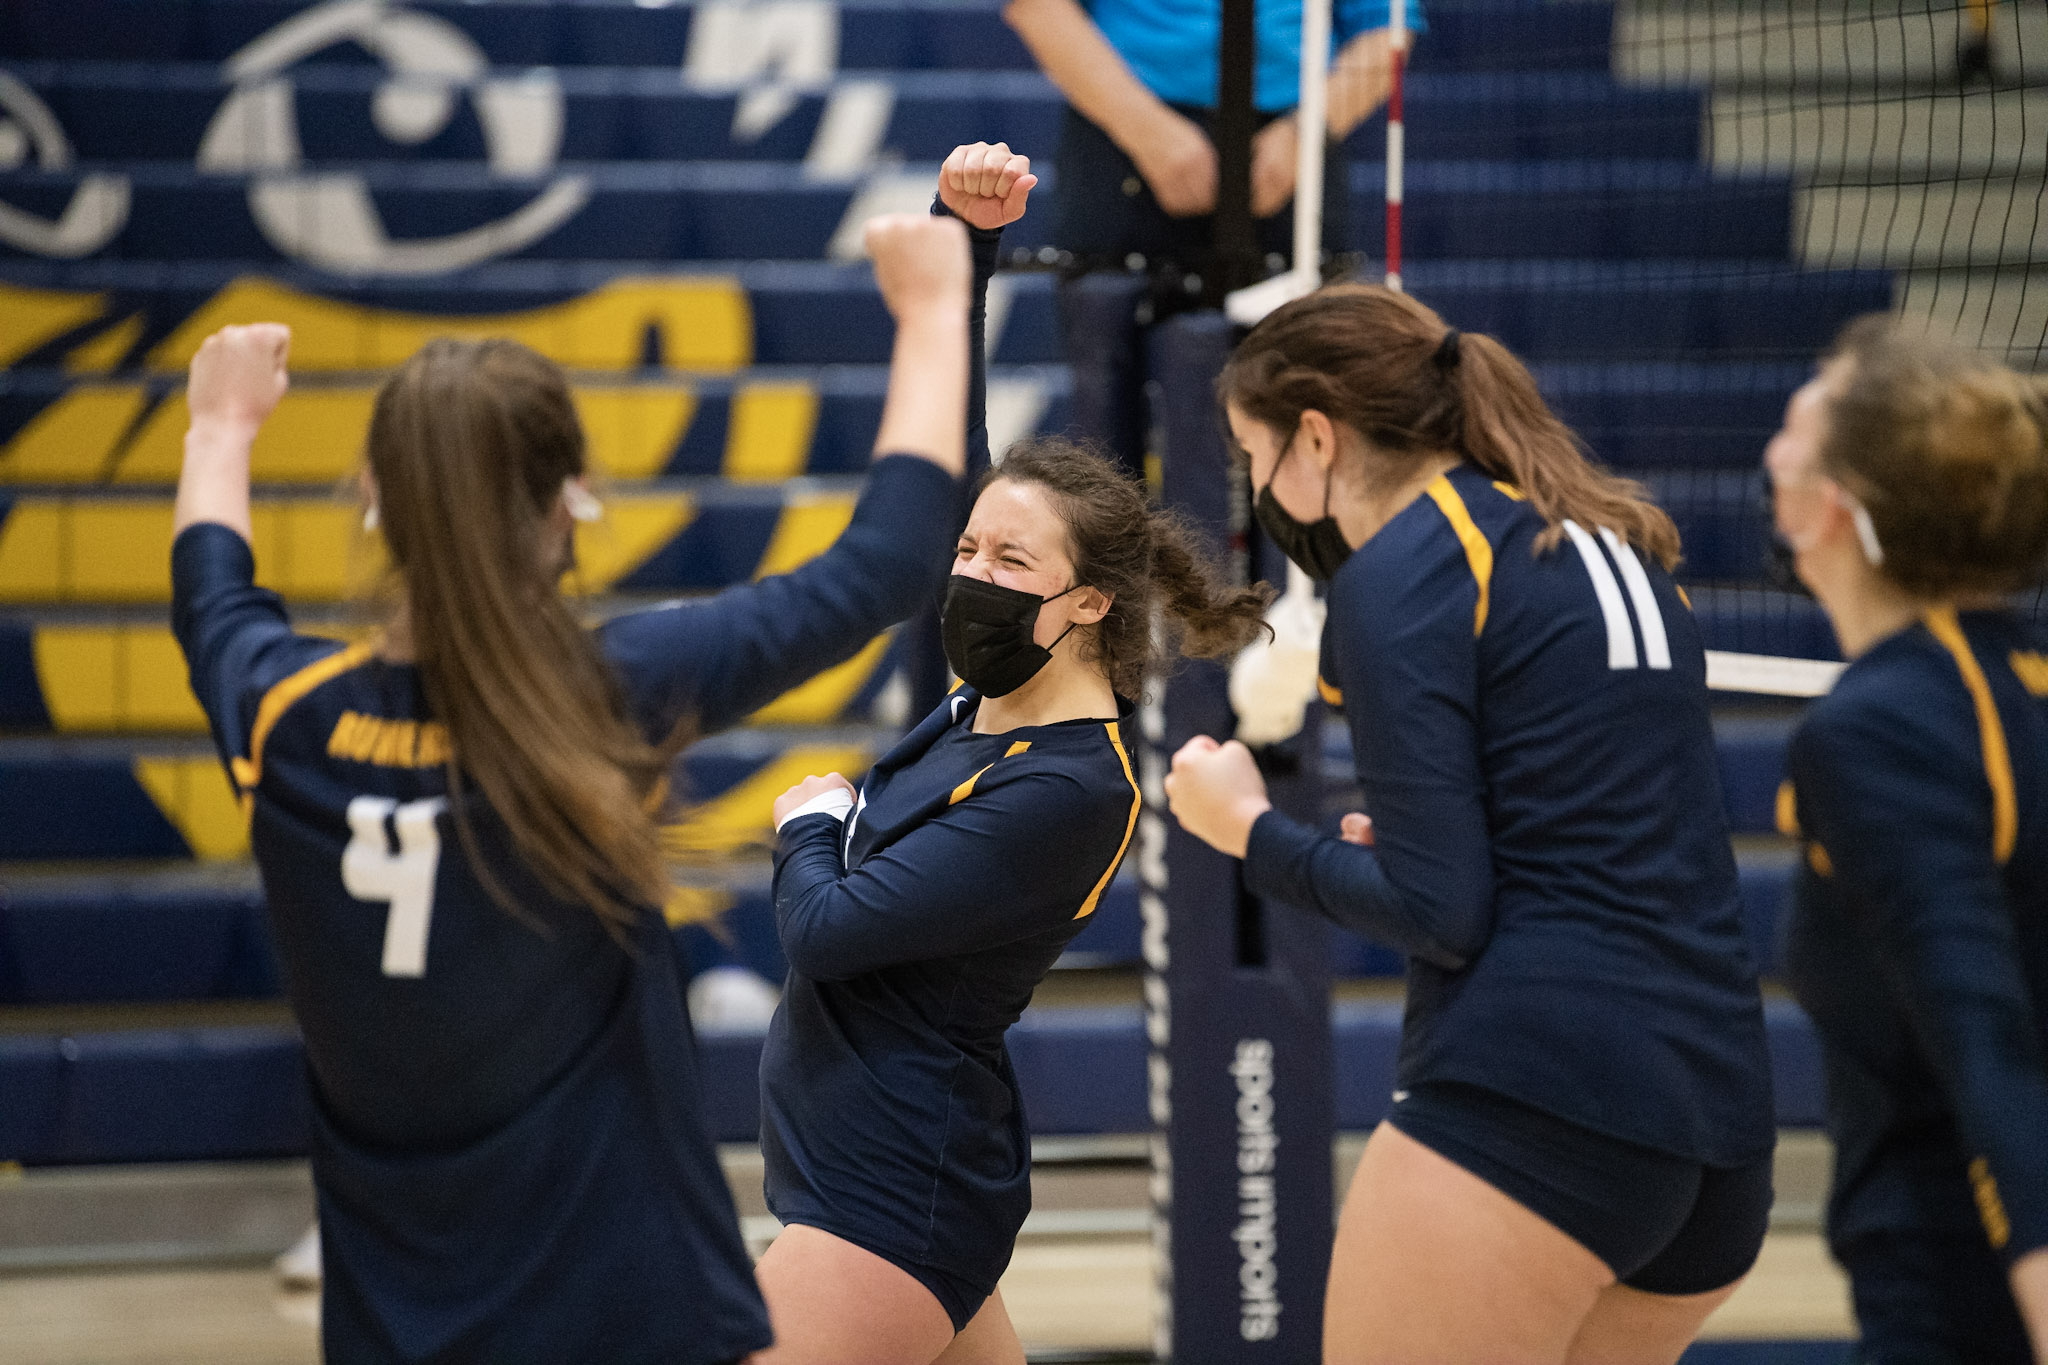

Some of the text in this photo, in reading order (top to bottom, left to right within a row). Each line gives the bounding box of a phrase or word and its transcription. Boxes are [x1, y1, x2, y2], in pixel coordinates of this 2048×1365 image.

[1562, 518, 1672, 670] 11
[341, 796, 446, 978] 4
[1229, 1038, 1283, 1341] sports imports
